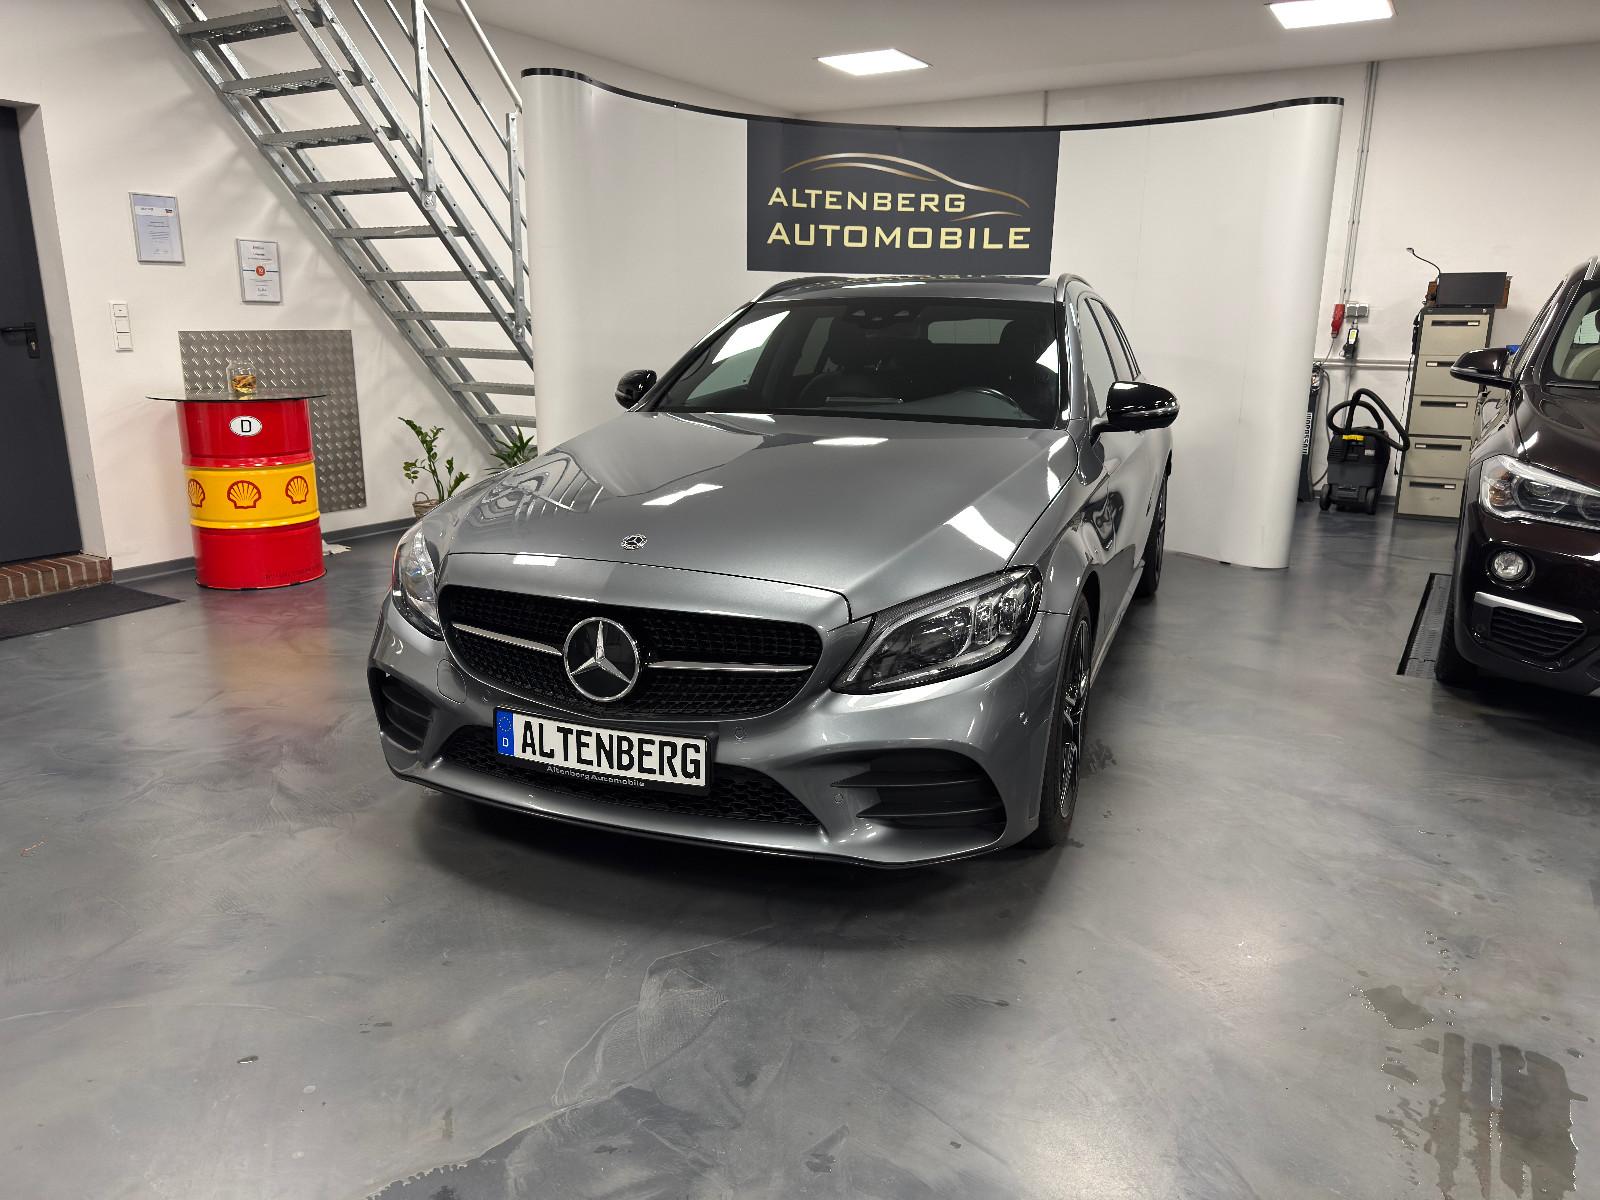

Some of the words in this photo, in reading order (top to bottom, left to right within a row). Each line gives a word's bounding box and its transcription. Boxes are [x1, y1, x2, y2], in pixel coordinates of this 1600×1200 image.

[767, 186, 966, 213] ALTENBERG
[766, 222, 1031, 249] AUTOMOBILE
[240, 419, 252, 433] D
[502, 737, 509, 747] D
[521, 720, 701, 779] ALTENBERG
[546, 765, 590, 780] Altenberg
[590, 774, 645, 787] Automobile
